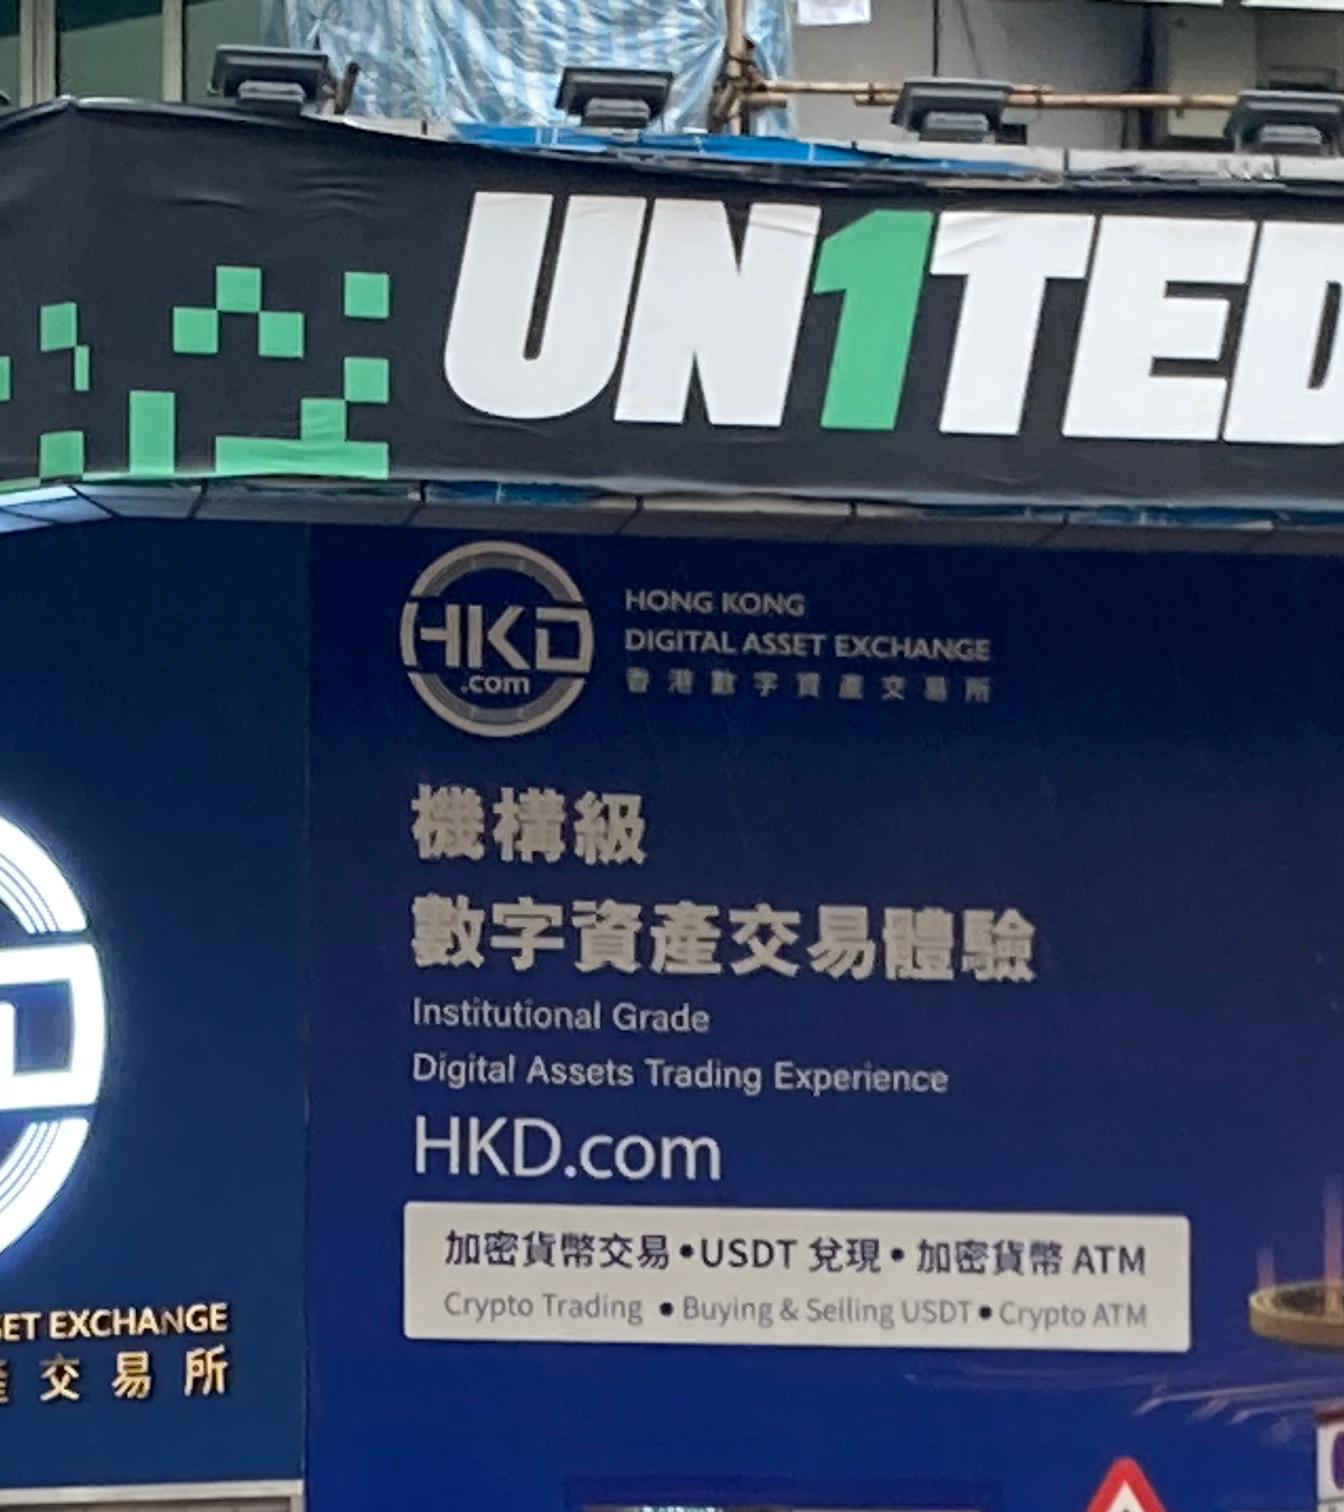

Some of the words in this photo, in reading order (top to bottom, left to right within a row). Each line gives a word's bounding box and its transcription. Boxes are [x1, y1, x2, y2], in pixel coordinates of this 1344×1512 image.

[625, 588, 713, 615] HONG
[721, 591, 805, 618] KONG
[400, 600, 594, 675] HKD
[625, 628, 736, 656] DIGITAL
[743, 631, 825, 658] ASSET
[836, 635, 991, 663] EXCHANGE
[625, 667, 993, 704] 香港數字資產交易所
[411, 783, 647, 866] 機構級
[411, 892, 1038, 984] 數字資產交易體驗
[412, 996, 602, 1032] Institutional
[611, 1003, 710, 1034] Grade
[412, 1053, 516, 1088] Digital
[527, 1056, 634, 1088] Assets
[646, 1058, 763, 1094] Trading
[775, 1061, 950, 1096] Experience
[413, 1113, 723, 1182] HKD.com
[444, 1228, 671, 1271] 加密貨幣交易
[700, 1237, 798, 1271] USDT
[916, 1239, 1062, 1277] 加密貨幣
[1072, 1244, 1148, 1277] ATM
[47, 1302, 229, 1341] EXCHANGE
[444, 1290, 534, 1327] Crypto
[542, 1292, 644, 1327] Trading
[683, 1296, 773, 1330] Buying
[779, 1299, 800, 1324] &
[806, 1297, 896, 1330] Selling
[901, 1299, 974, 1326] USDT
[999, 1300, 1086, 1332] Crypto
[1093, 1304, 1148, 1329] ATM
